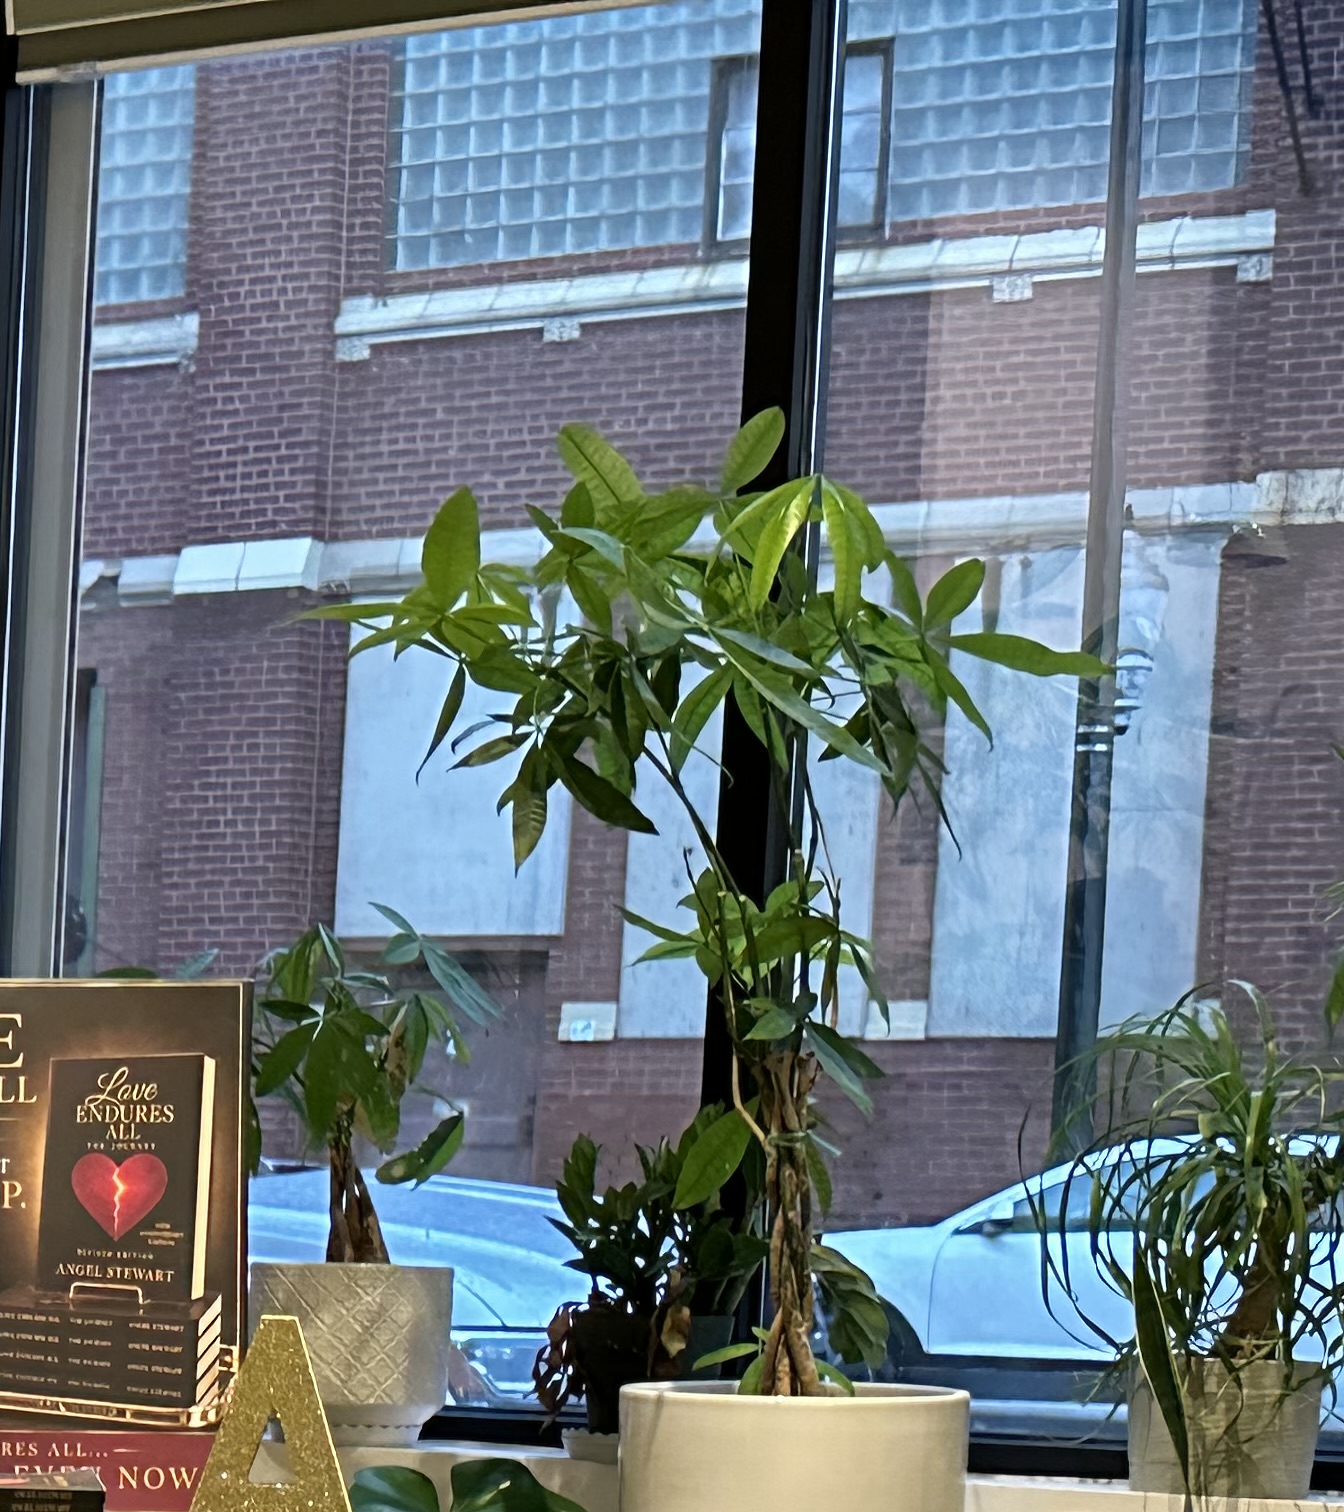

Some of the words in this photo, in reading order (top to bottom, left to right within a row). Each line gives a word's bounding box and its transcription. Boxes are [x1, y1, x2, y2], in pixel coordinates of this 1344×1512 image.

[84, 1066, 158, 1107] Love
[76, 1103, 175, 1124] ENDURES
[105, 1122, 142, 1140] ALL
[55, 1263, 103, 1278] ANGEL
[105, 1265, 176, 1283] STEWART
[47, 1442, 109, 1459] ALL...
[118, 1465, 199, 1490] NOW
